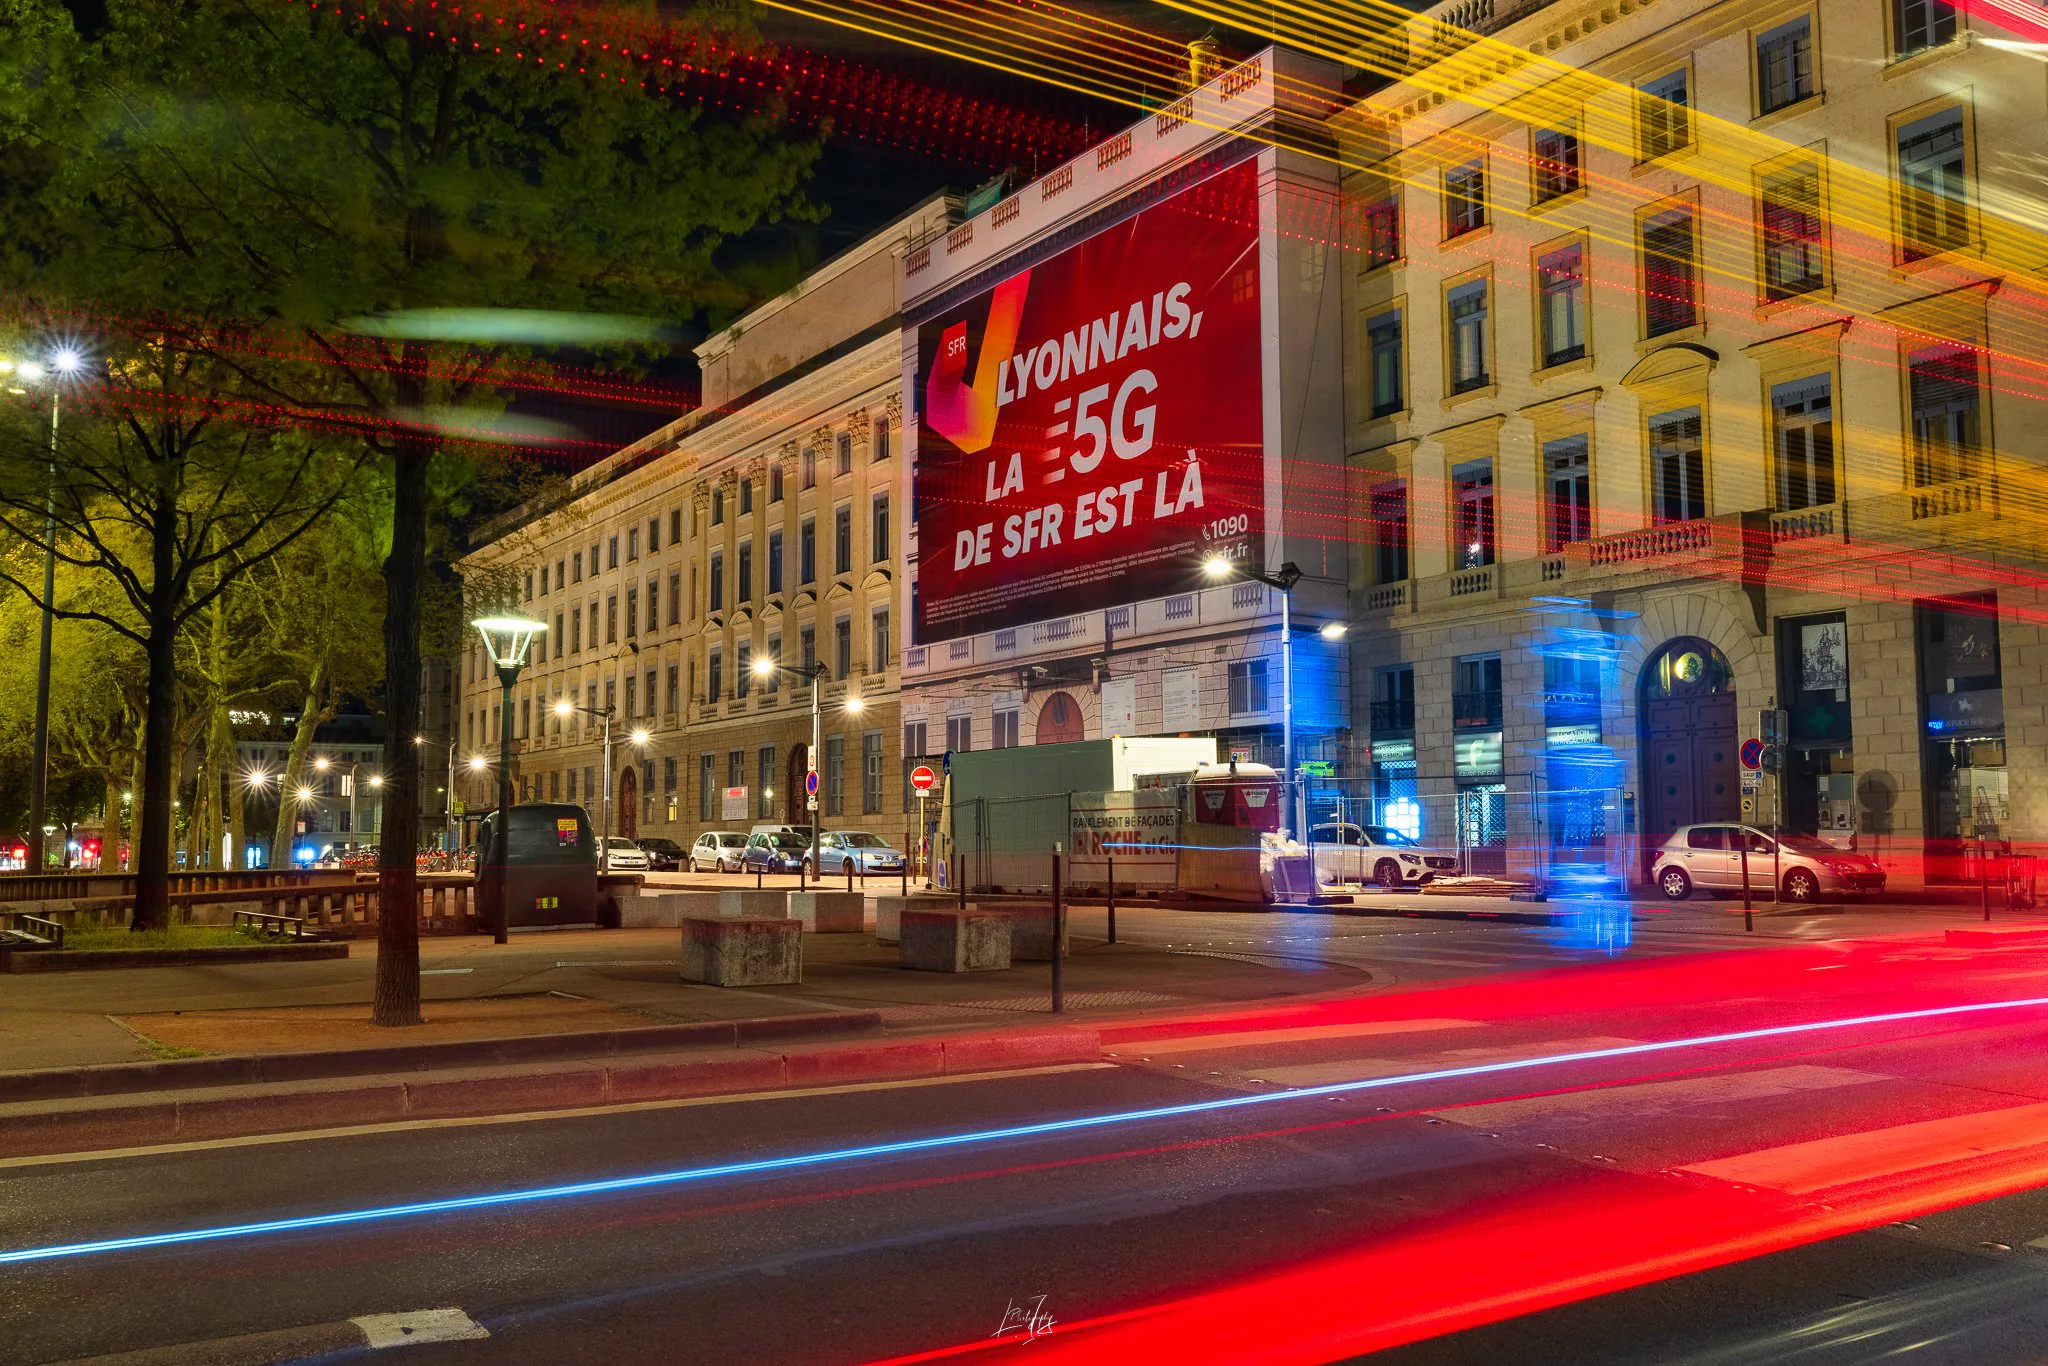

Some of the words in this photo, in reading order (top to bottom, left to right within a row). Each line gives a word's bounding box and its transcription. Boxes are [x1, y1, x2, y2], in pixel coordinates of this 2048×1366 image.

[948, 336, 966, 357] SFR
[995, 281, 1204, 408] LYONNAIS,
[1069, 368, 1159, 475] 5G
[985, 452, 1025, 503] LA
[953, 520, 993, 572] DE
[1001, 502, 1064, 559] SFR
[1073, 478, 1144, 541] EST
[1152, 448, 1205, 519] LÀ
[1211, 513, 1248, 539] 1090
[1552, 737, 1596, 746] TRANSACTION
[1073, 816, 1123, 828] RAVALEMENT
[1124, 816, 1136, 827] DE
[1091, 830, 1142, 856] ROCHE
[1145, 837, 1156, 855] et
[1159, 834, 1175, 855] Cie
